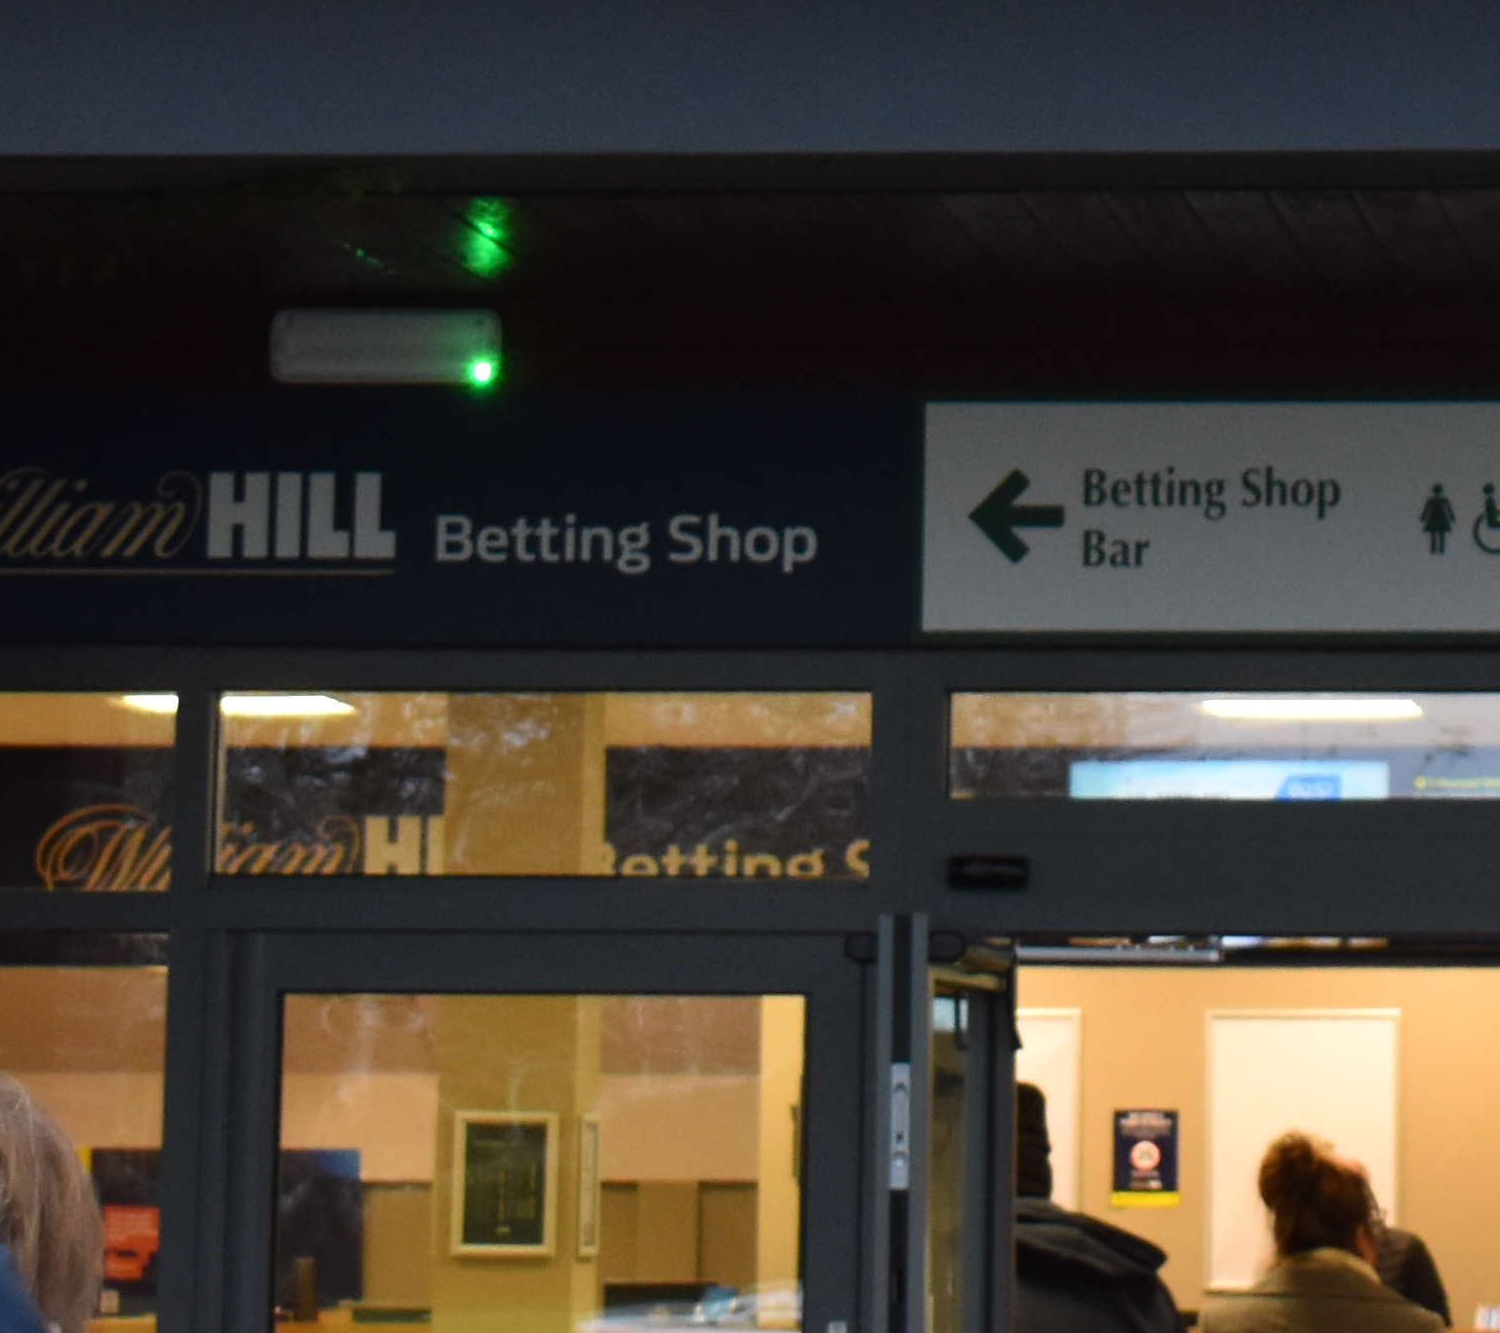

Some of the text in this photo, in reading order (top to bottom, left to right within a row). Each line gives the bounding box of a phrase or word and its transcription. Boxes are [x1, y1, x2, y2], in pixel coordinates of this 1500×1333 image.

[206, 471, 396, 559] HILL
[1083, 464, 1341, 521] Betting Shop
[435, 513, 818, 574] Betting Shop
[1082, 529, 1150, 567] Bar
